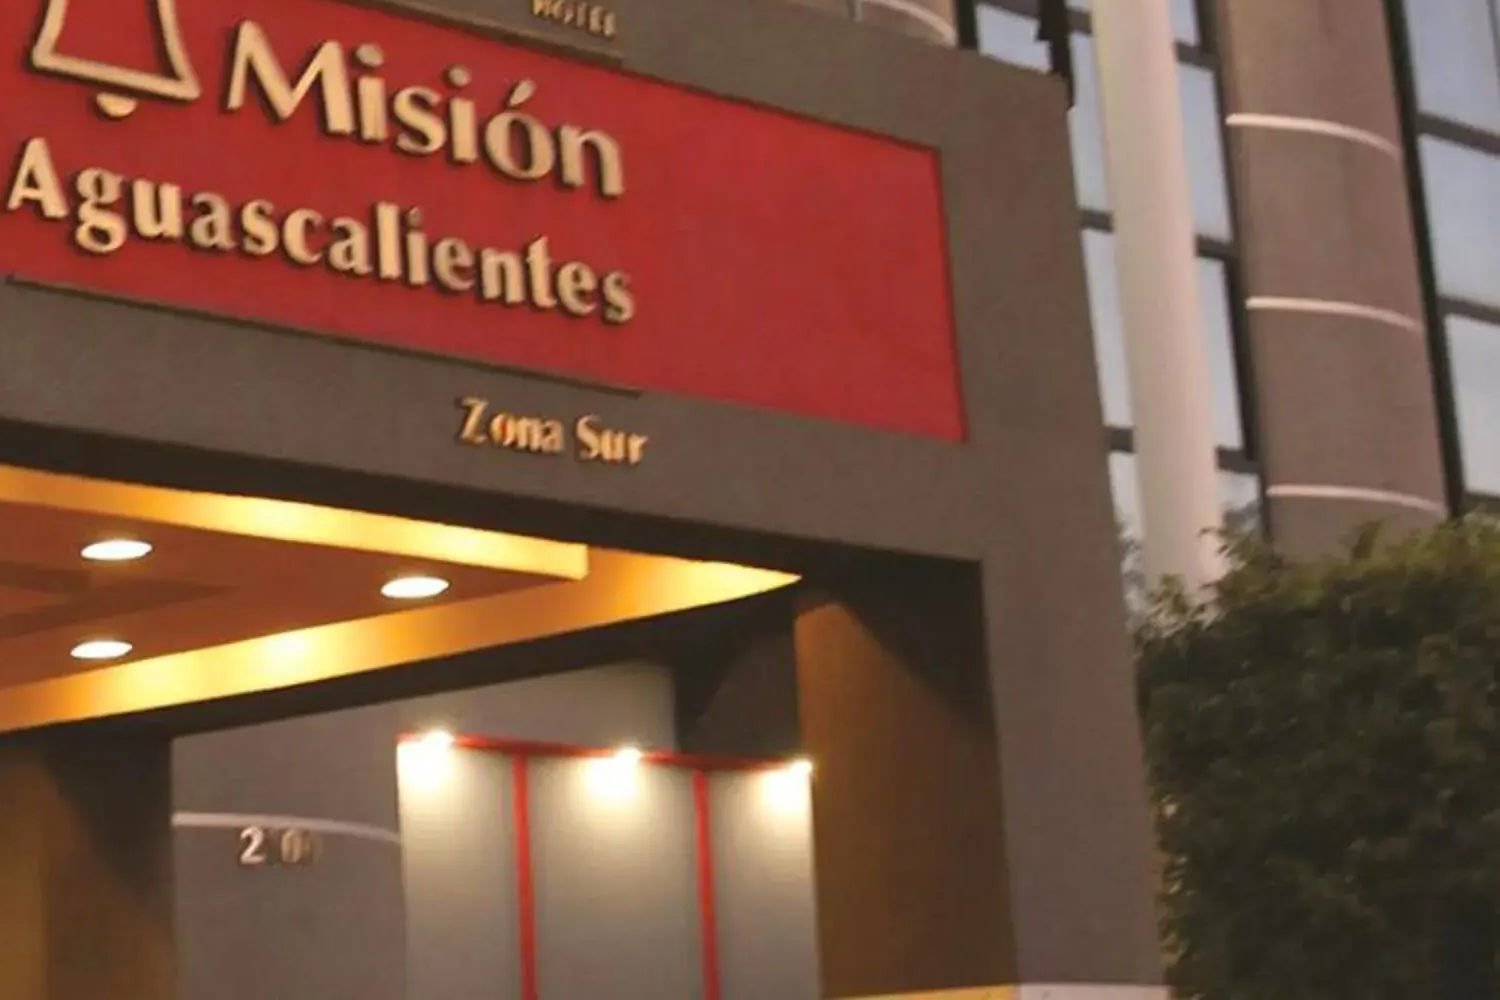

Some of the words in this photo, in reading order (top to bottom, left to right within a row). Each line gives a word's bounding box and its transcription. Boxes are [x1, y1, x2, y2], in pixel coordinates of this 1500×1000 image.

[227, 19, 625, 198] Misión
[6, 137, 635, 324] Aguascalientes
[461, 396, 565, 452] Zona
[576, 413, 649, 465] Sur
